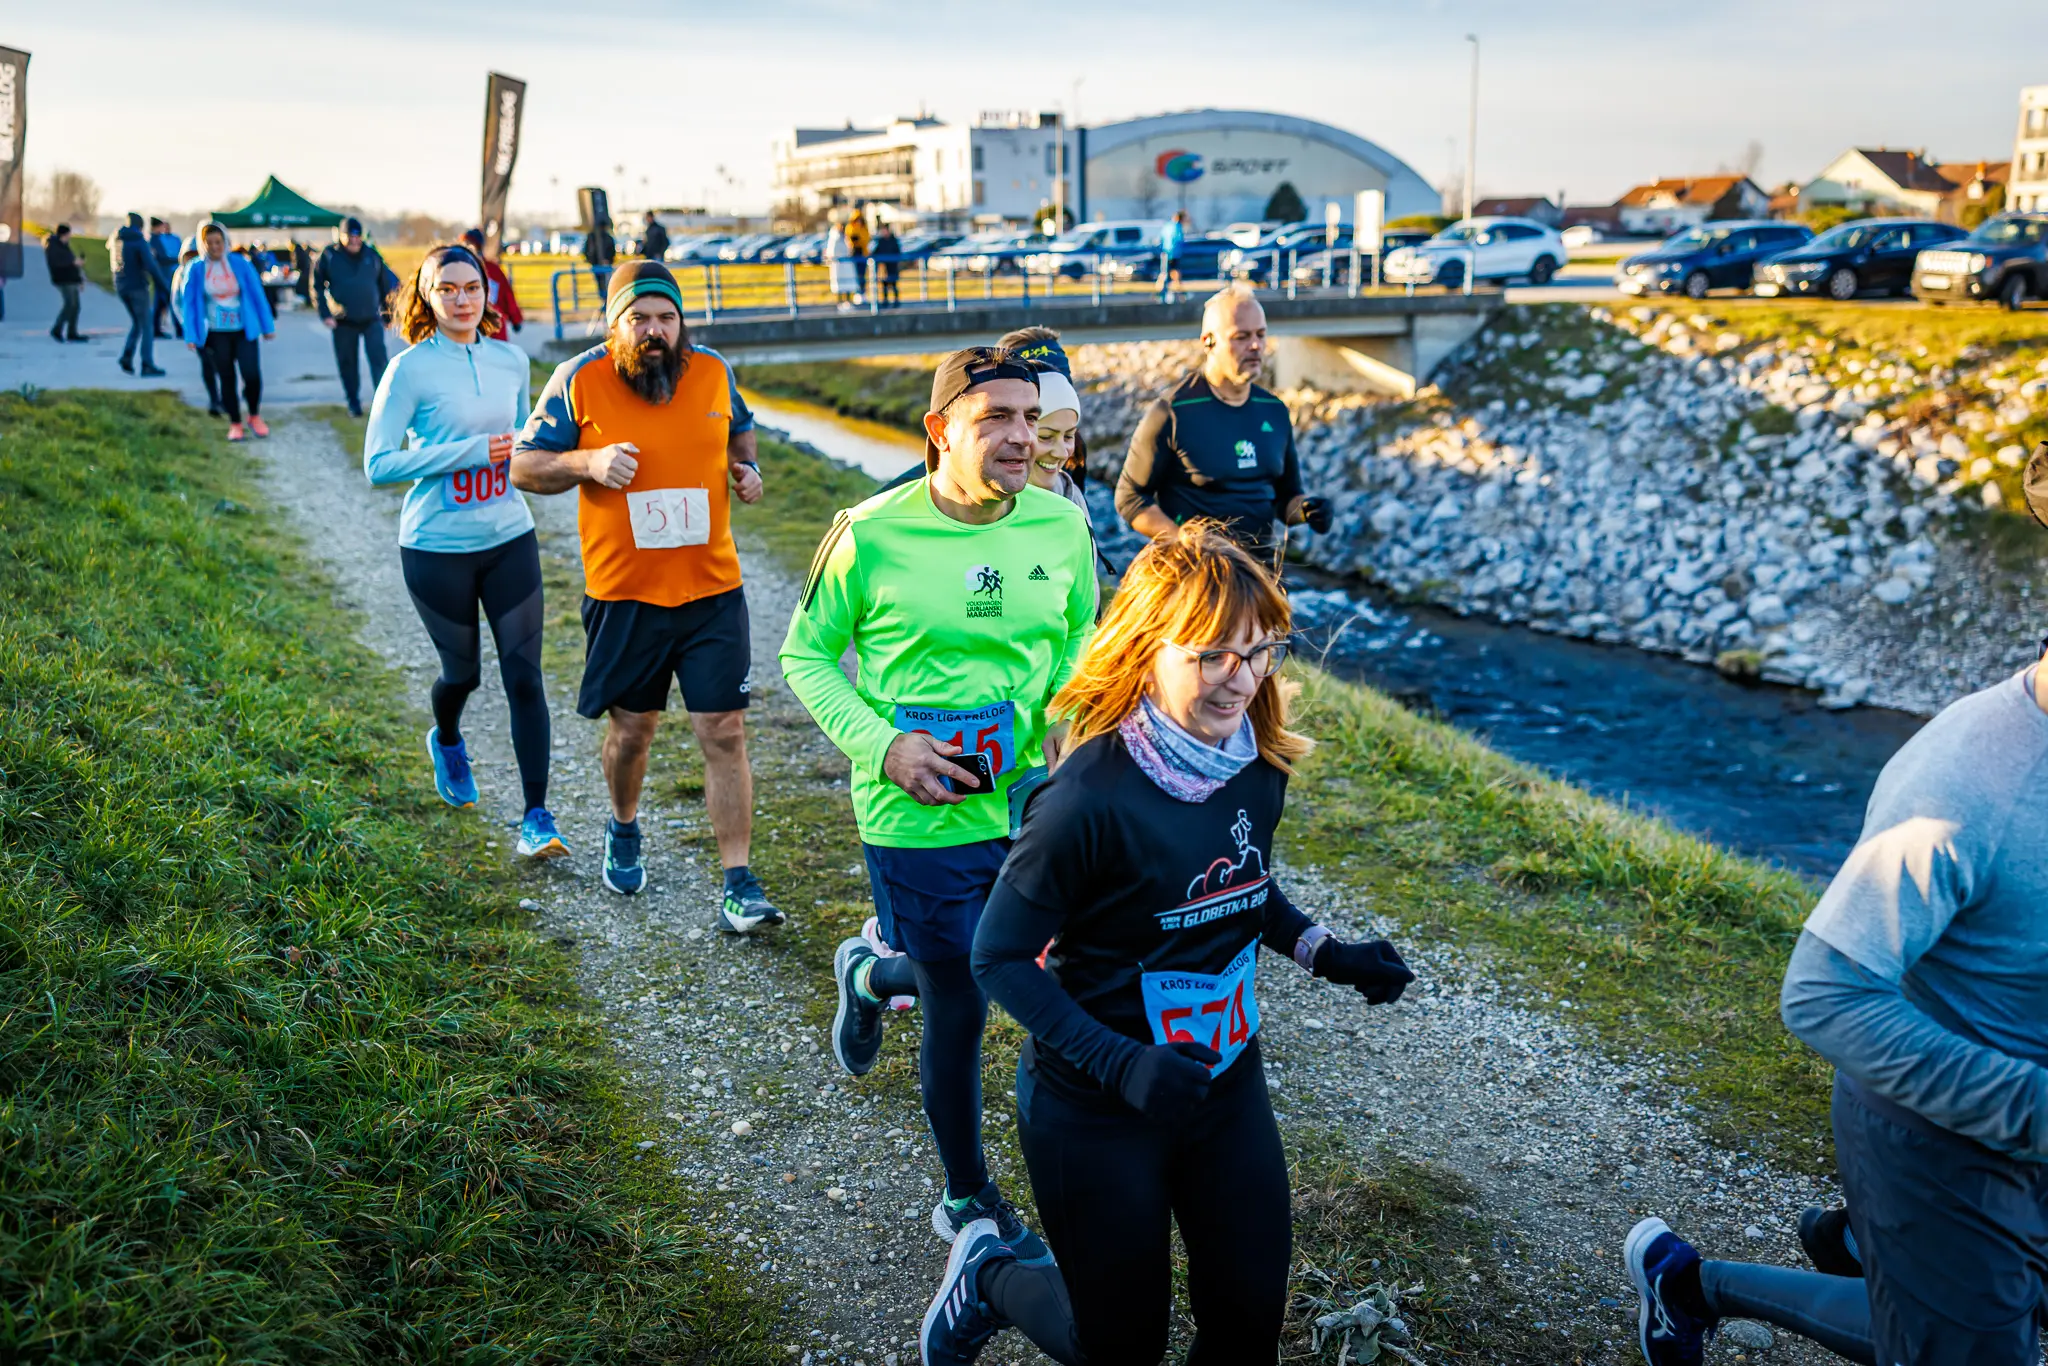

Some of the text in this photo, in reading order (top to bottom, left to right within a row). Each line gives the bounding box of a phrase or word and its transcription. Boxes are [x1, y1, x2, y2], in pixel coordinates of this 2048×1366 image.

[453, 462, 507, 504] 905
[645, 496, 689, 533] 51
[905, 705, 1006, 722] KROS LIGA PRELOG
[1160, 979, 1192, 991] KROS
